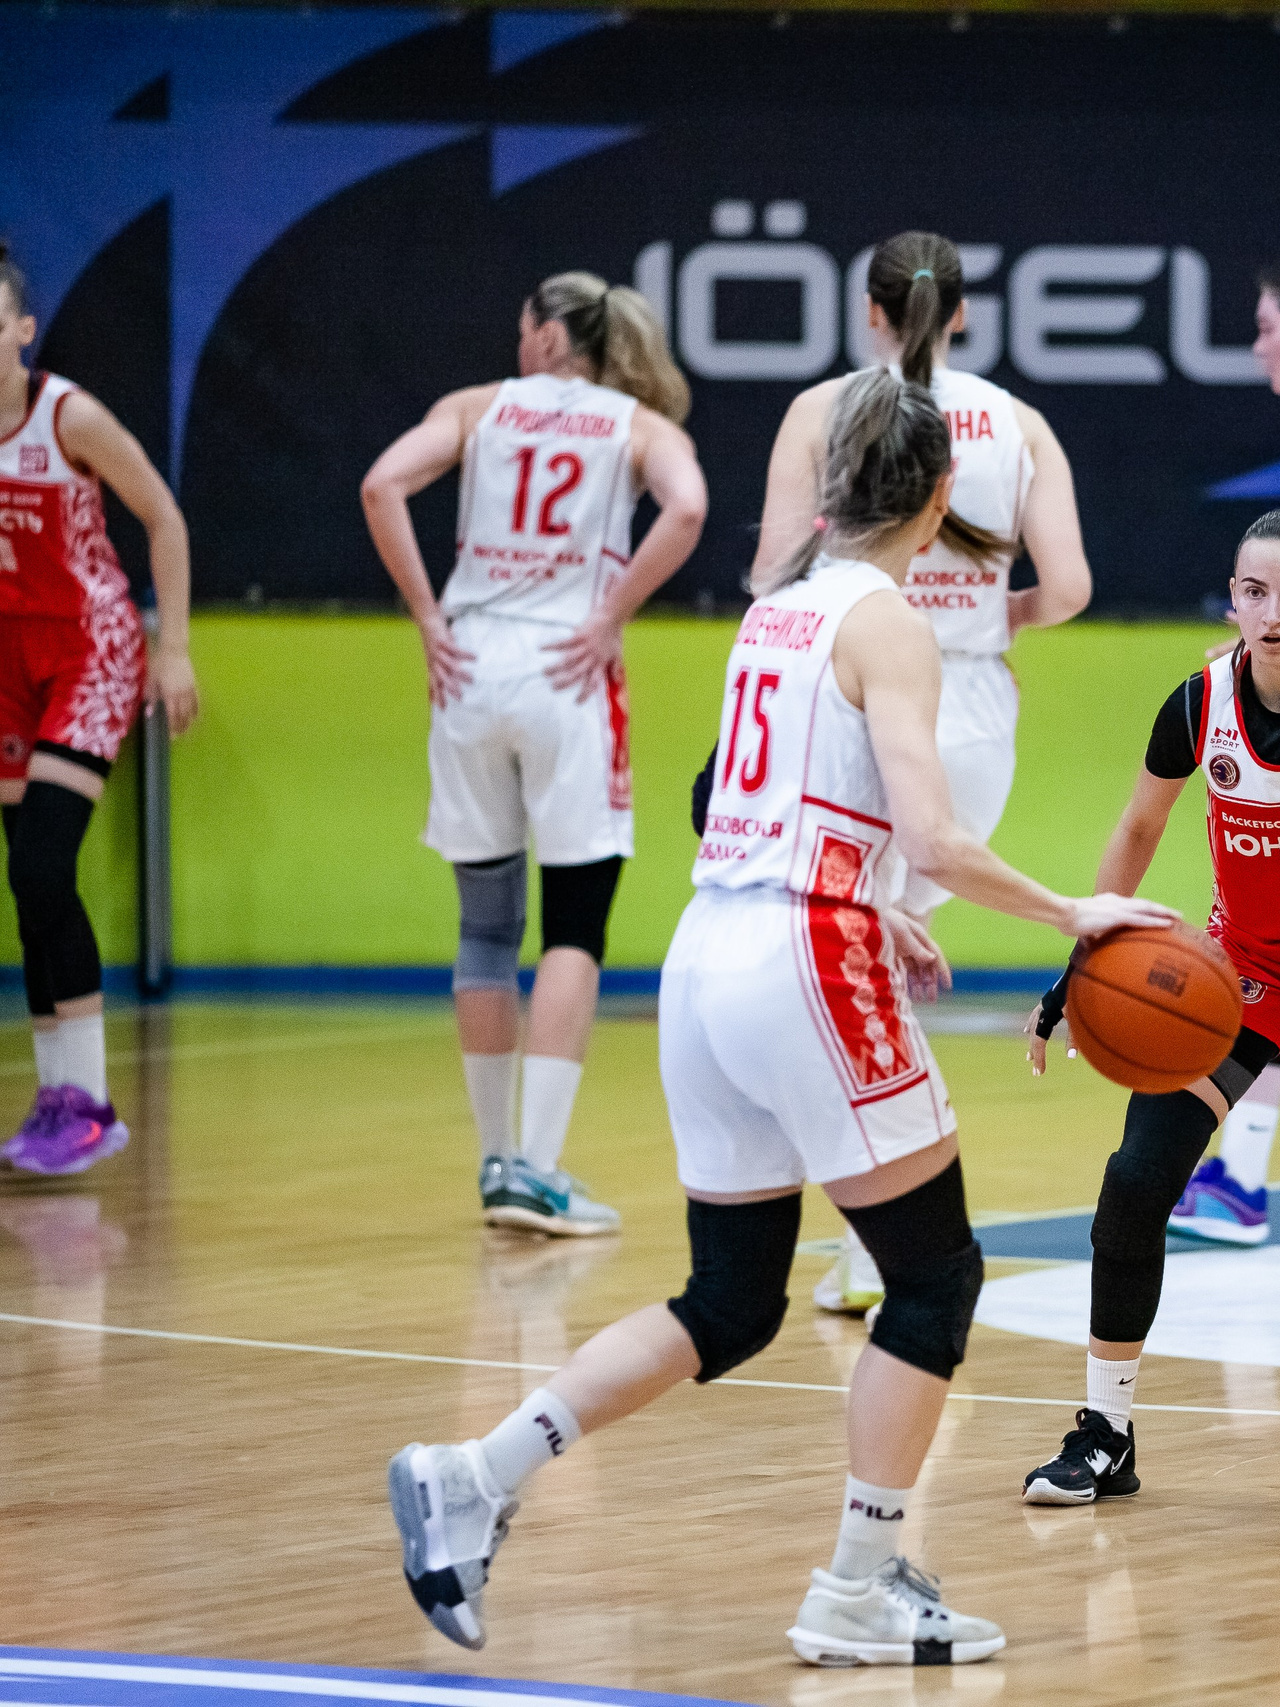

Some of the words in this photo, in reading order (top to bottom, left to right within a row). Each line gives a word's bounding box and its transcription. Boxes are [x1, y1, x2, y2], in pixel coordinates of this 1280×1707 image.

[509, 446, 585, 537] 12
[910, 570, 998, 588] КОВСКАЯ
[905, 593, 977, 609] БЛАСТЬ
[720, 666, 783, 798] 15
[1210, 737, 1240, 749] SPORT
[534, 1412, 565, 1457] FIL
[850, 1498, 904, 1521] FILA
